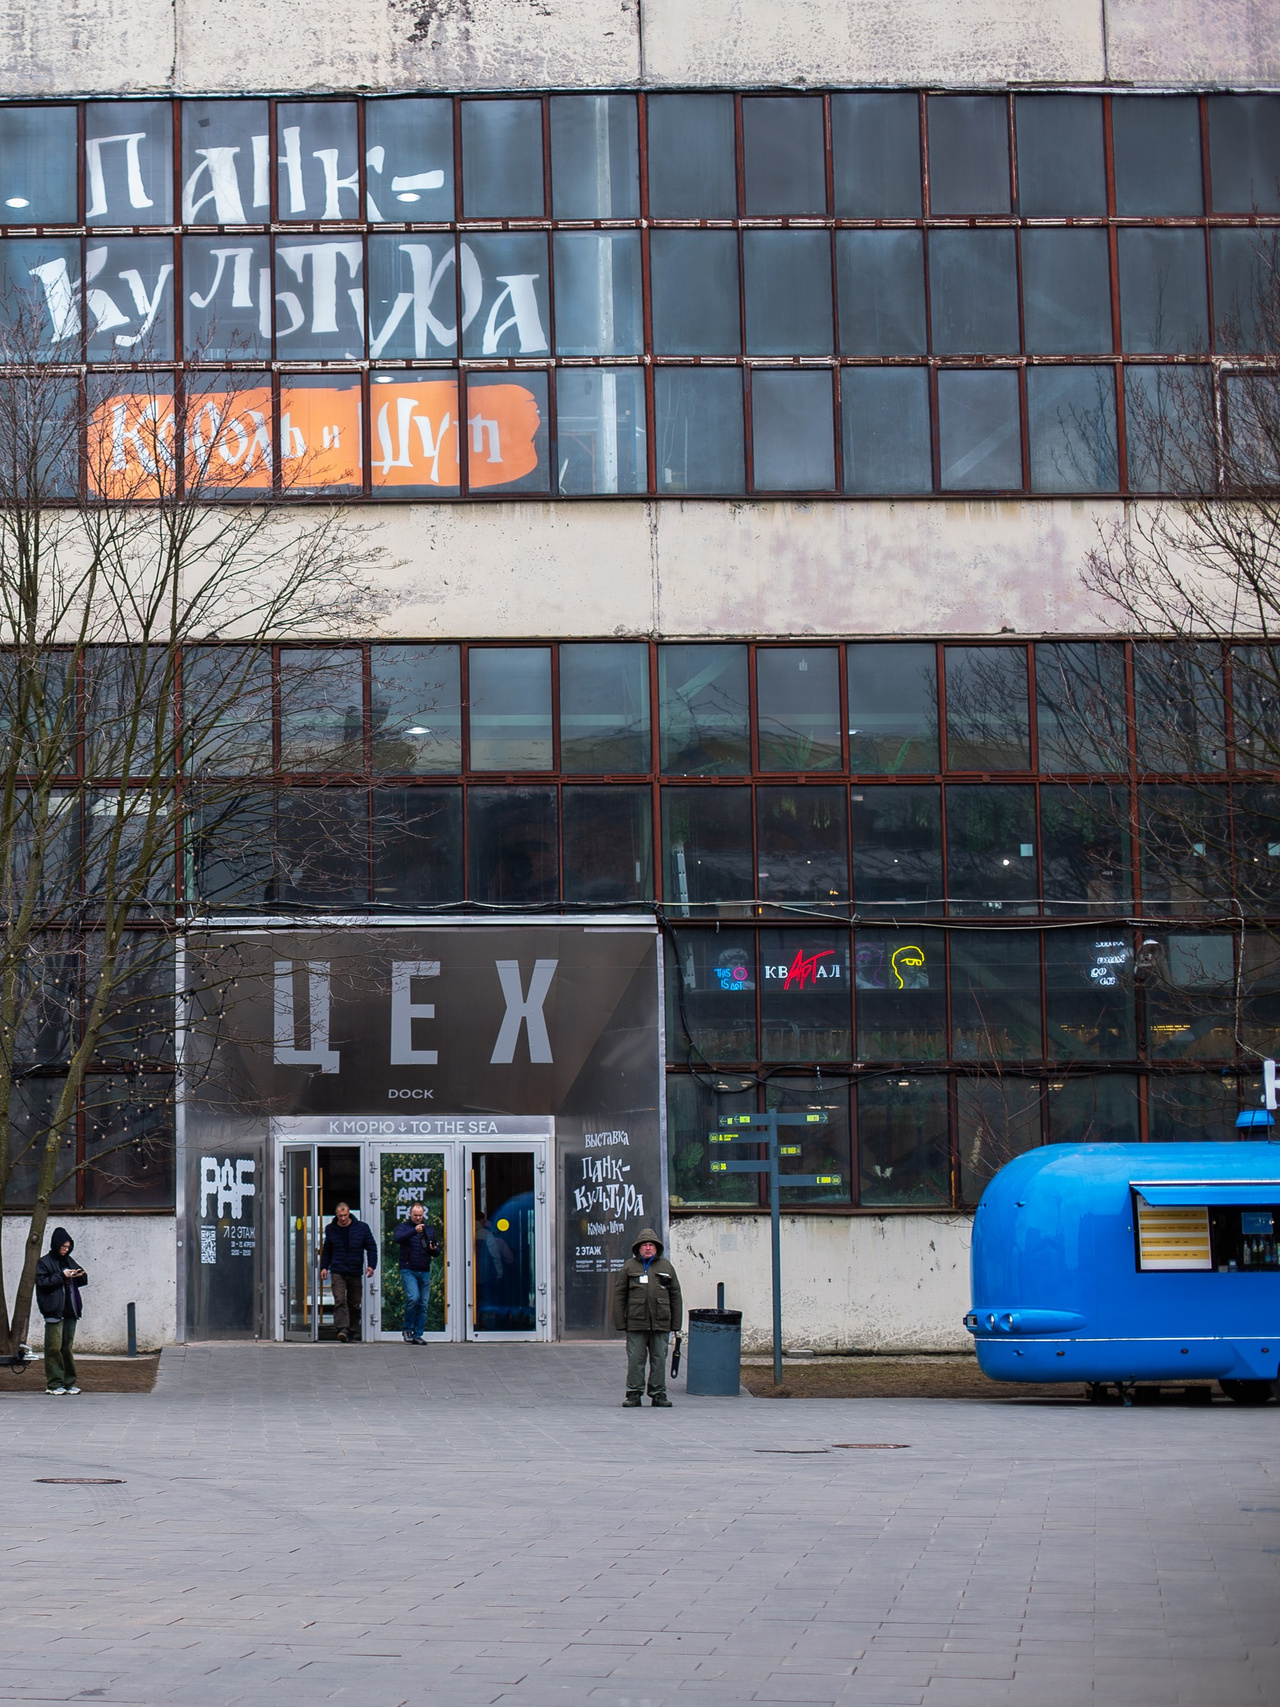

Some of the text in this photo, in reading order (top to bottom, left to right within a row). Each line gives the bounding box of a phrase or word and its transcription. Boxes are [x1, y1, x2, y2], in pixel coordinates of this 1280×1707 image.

[713, 967, 732, 979] THIS
[720, 978, 744, 991] IS ART
[273, 958, 560, 1074] ЦЕХ
[388, 1089, 434, 1099] DOCK
[329, 1121, 499, 1134] К МОРЮ TO THE SEA
[393, 1168, 431, 1182] PORT
[200, 1156, 256, 1220] PAF
[398, 1187, 427, 1201] ART
[231, 1226, 256, 1239] 2 ЭТАЖ
[575, 1246, 601, 1256] 2 ЭТАЖ
